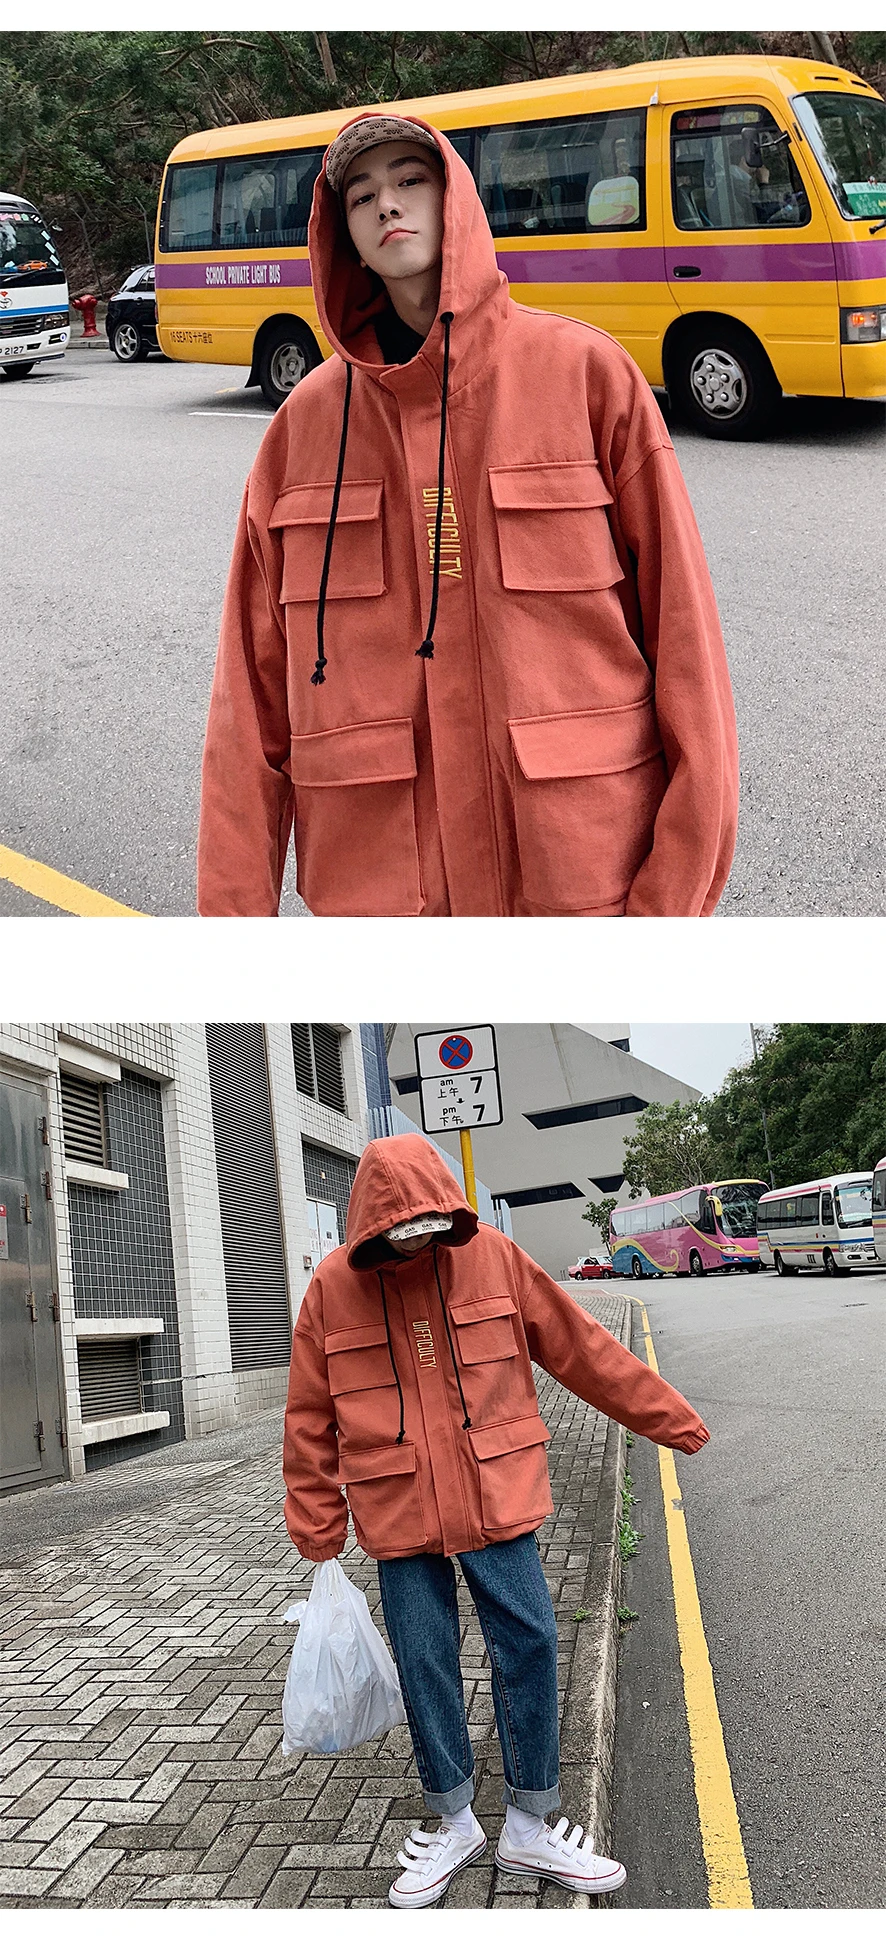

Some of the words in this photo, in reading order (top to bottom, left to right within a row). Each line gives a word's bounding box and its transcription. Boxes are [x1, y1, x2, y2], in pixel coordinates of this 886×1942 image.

[205, 266, 226, 284] SCHOOL
[227, 265, 250, 284] PRIVATE
[251, 264, 267, 284] LIGHT
[268, 264, 280, 284] BUS
[4, 346, 24, 355] 2127
[422, 487, 462, 580] DIFFICULTY
[440, 1078, 454, 1087] am
[470, 1075, 483, 1094] 7
[437, 1087, 459, 1099] 上午
[442, 1106, 457, 1116] pm
[472, 1104, 485, 1122] 7
[439, 1115, 461, 1127] 下午
[404, 1226, 416, 1234] GAS
[412, 1320, 437, 1369] DIFFICULTY
